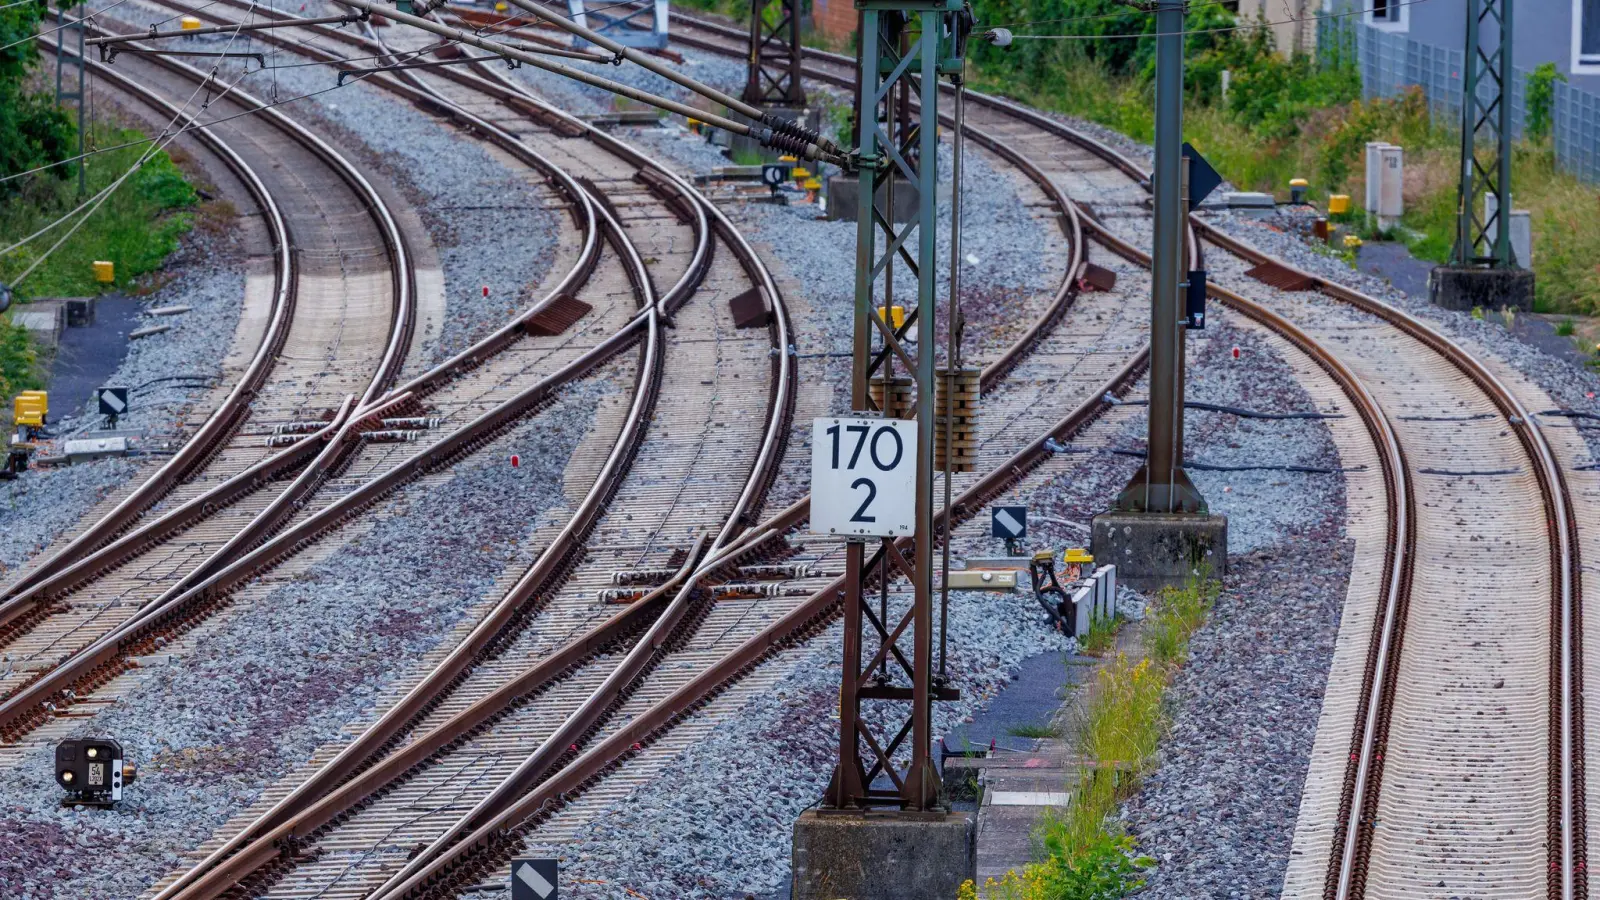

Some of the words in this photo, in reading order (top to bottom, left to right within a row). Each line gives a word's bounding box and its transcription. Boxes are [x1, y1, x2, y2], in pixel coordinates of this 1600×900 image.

[826, 425, 903, 472] 170
[849, 477, 877, 523] 2
[92, 766, 100, 775] 54
